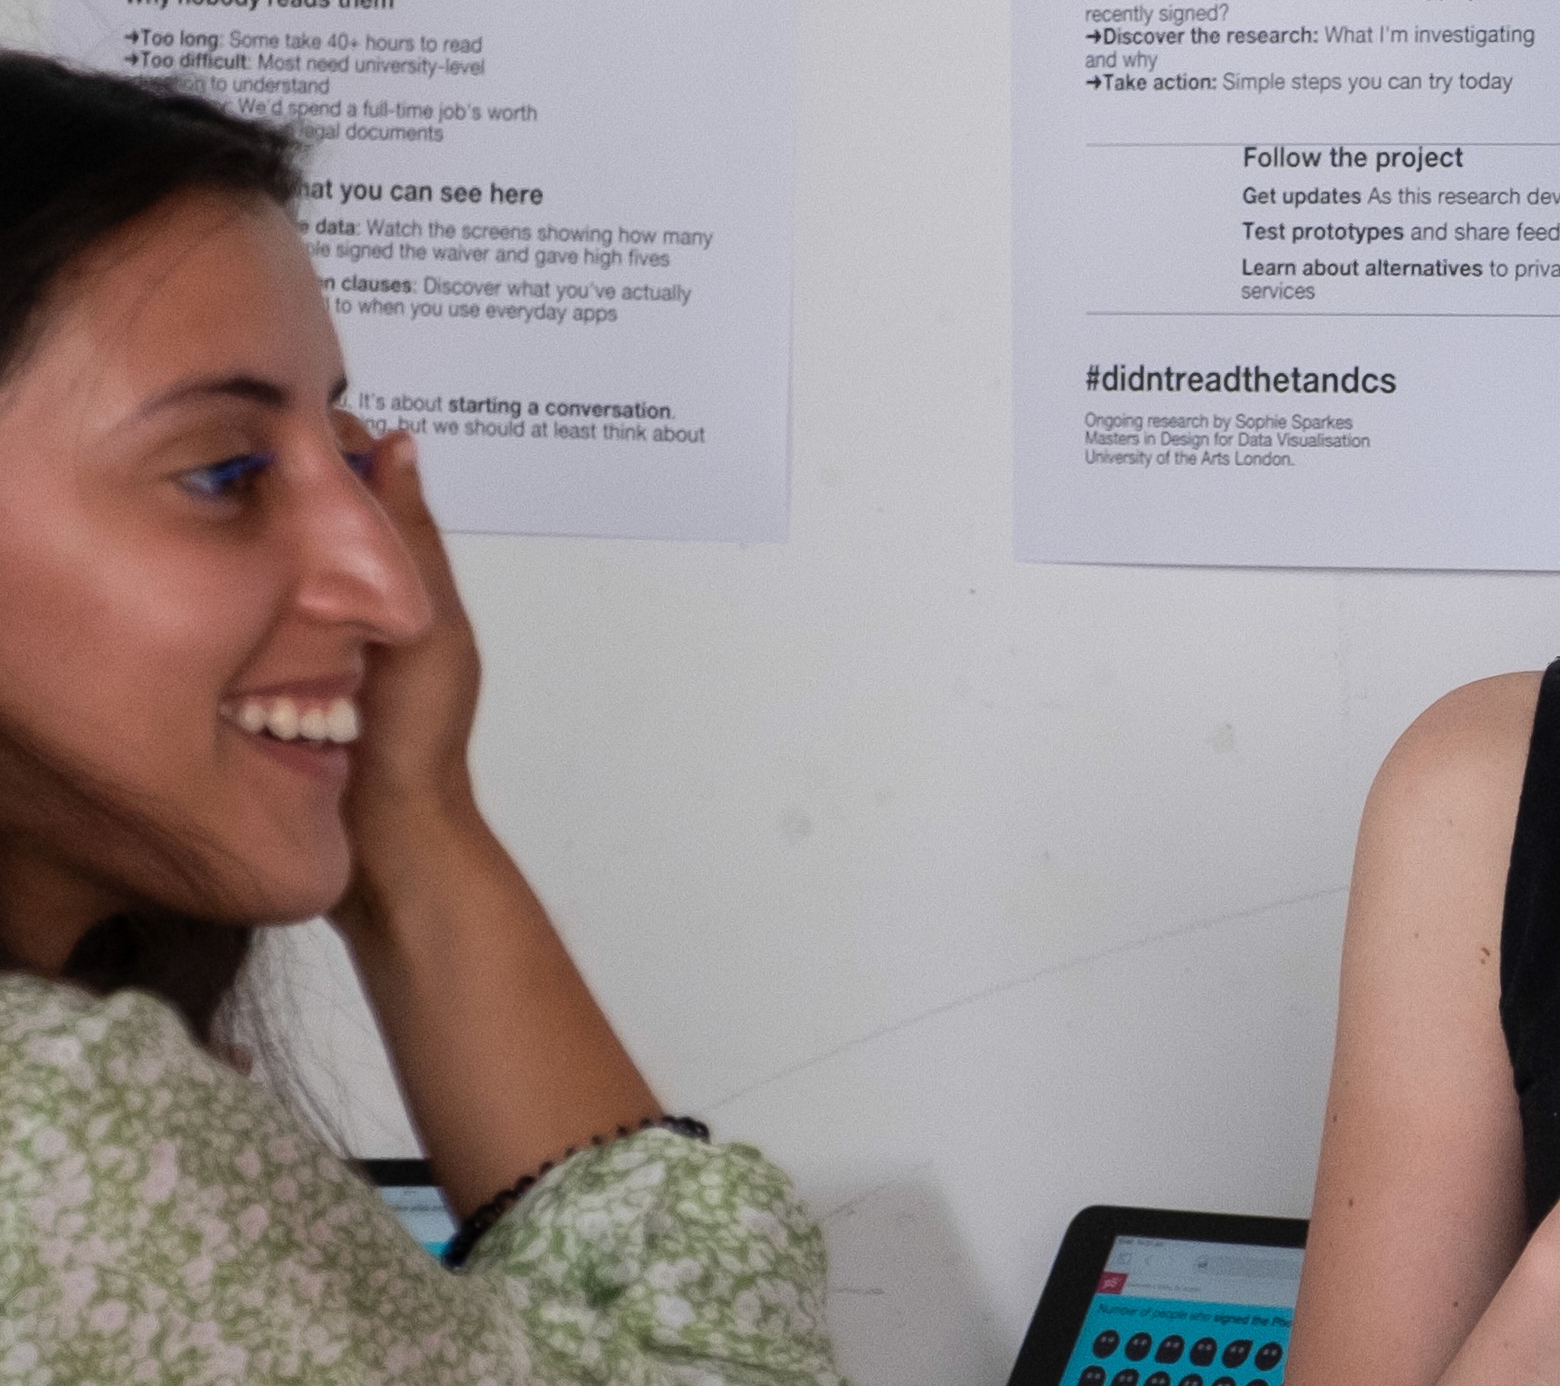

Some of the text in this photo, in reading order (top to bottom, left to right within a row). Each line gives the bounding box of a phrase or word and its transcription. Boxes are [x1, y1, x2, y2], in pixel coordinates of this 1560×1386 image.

[1244, 145, 1463, 173] Follow the project
[1242, 186, 1276, 204] Get
[1282, 187, 1361, 208] updates
[1367, 187, 1391, 204] As
[1398, 187, 1431, 204] this
[1438, 188, 1520, 204] research
[1242, 221, 1285, 240] Test
[1292, 223, 1404, 245] prototypes
[1411, 223, 1447, 241] and
[1455, 222, 1509, 241] share
[1242, 258, 1296, 276] Learn
[1302, 259, 1359, 277] about
[1365, 259, 1483, 277] alternatives
[1489, 261, 1508, 277] to
[1242, 282, 1316, 300] services
[1086, 364, 1396, 393] #didntreadthetandcs
